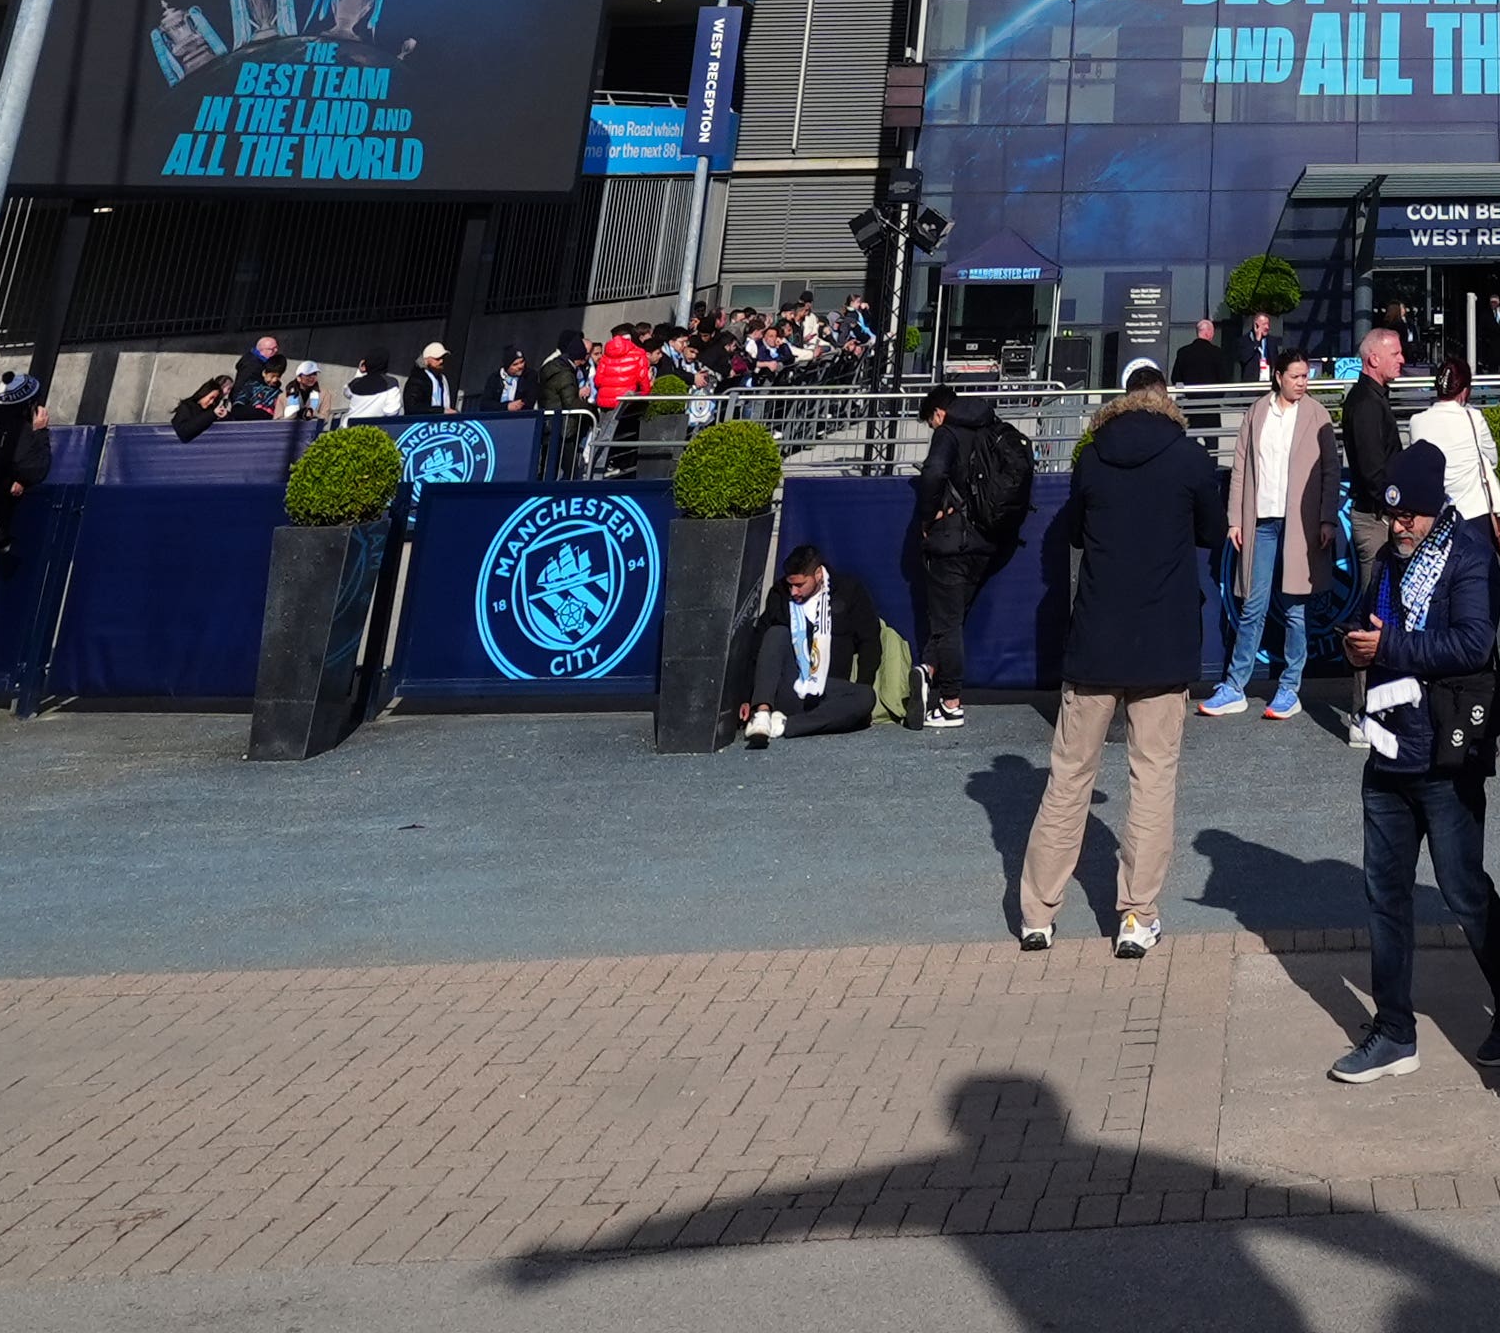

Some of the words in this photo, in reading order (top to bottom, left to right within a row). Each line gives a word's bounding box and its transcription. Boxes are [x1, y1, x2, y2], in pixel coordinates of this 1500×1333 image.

[304, 42, 340, 63] THE
[709, 18, 726, 58] WEST
[1202, 27, 1295, 84] AND
[1299, 12, 1413, 95] ALL
[234, 62, 308, 97] BEST
[310, 67, 391, 100] TEAM
[193, 96, 234, 132] IN
[234, 97, 292, 133] THE
[291, 100, 369, 136] LAND
[371, 108, 413, 132] AND
[699, 61, 719, 144] RECEPTION
[626, 121, 654, 137] Road
[161, 133, 227, 176] ALL
[234, 135, 299, 177] THE
[300, 137, 424, 181] WORLD
[1407, 204, 1469, 220] COLIN
[1410, 229, 1470, 246] WEST
[475, 453, 487, 461] 94
[495, 497, 635, 578] MANCHESTER
[627, 557, 646, 572] 94
[492, 599, 507, 613] 18
[550, 644, 601, 676] CITY
